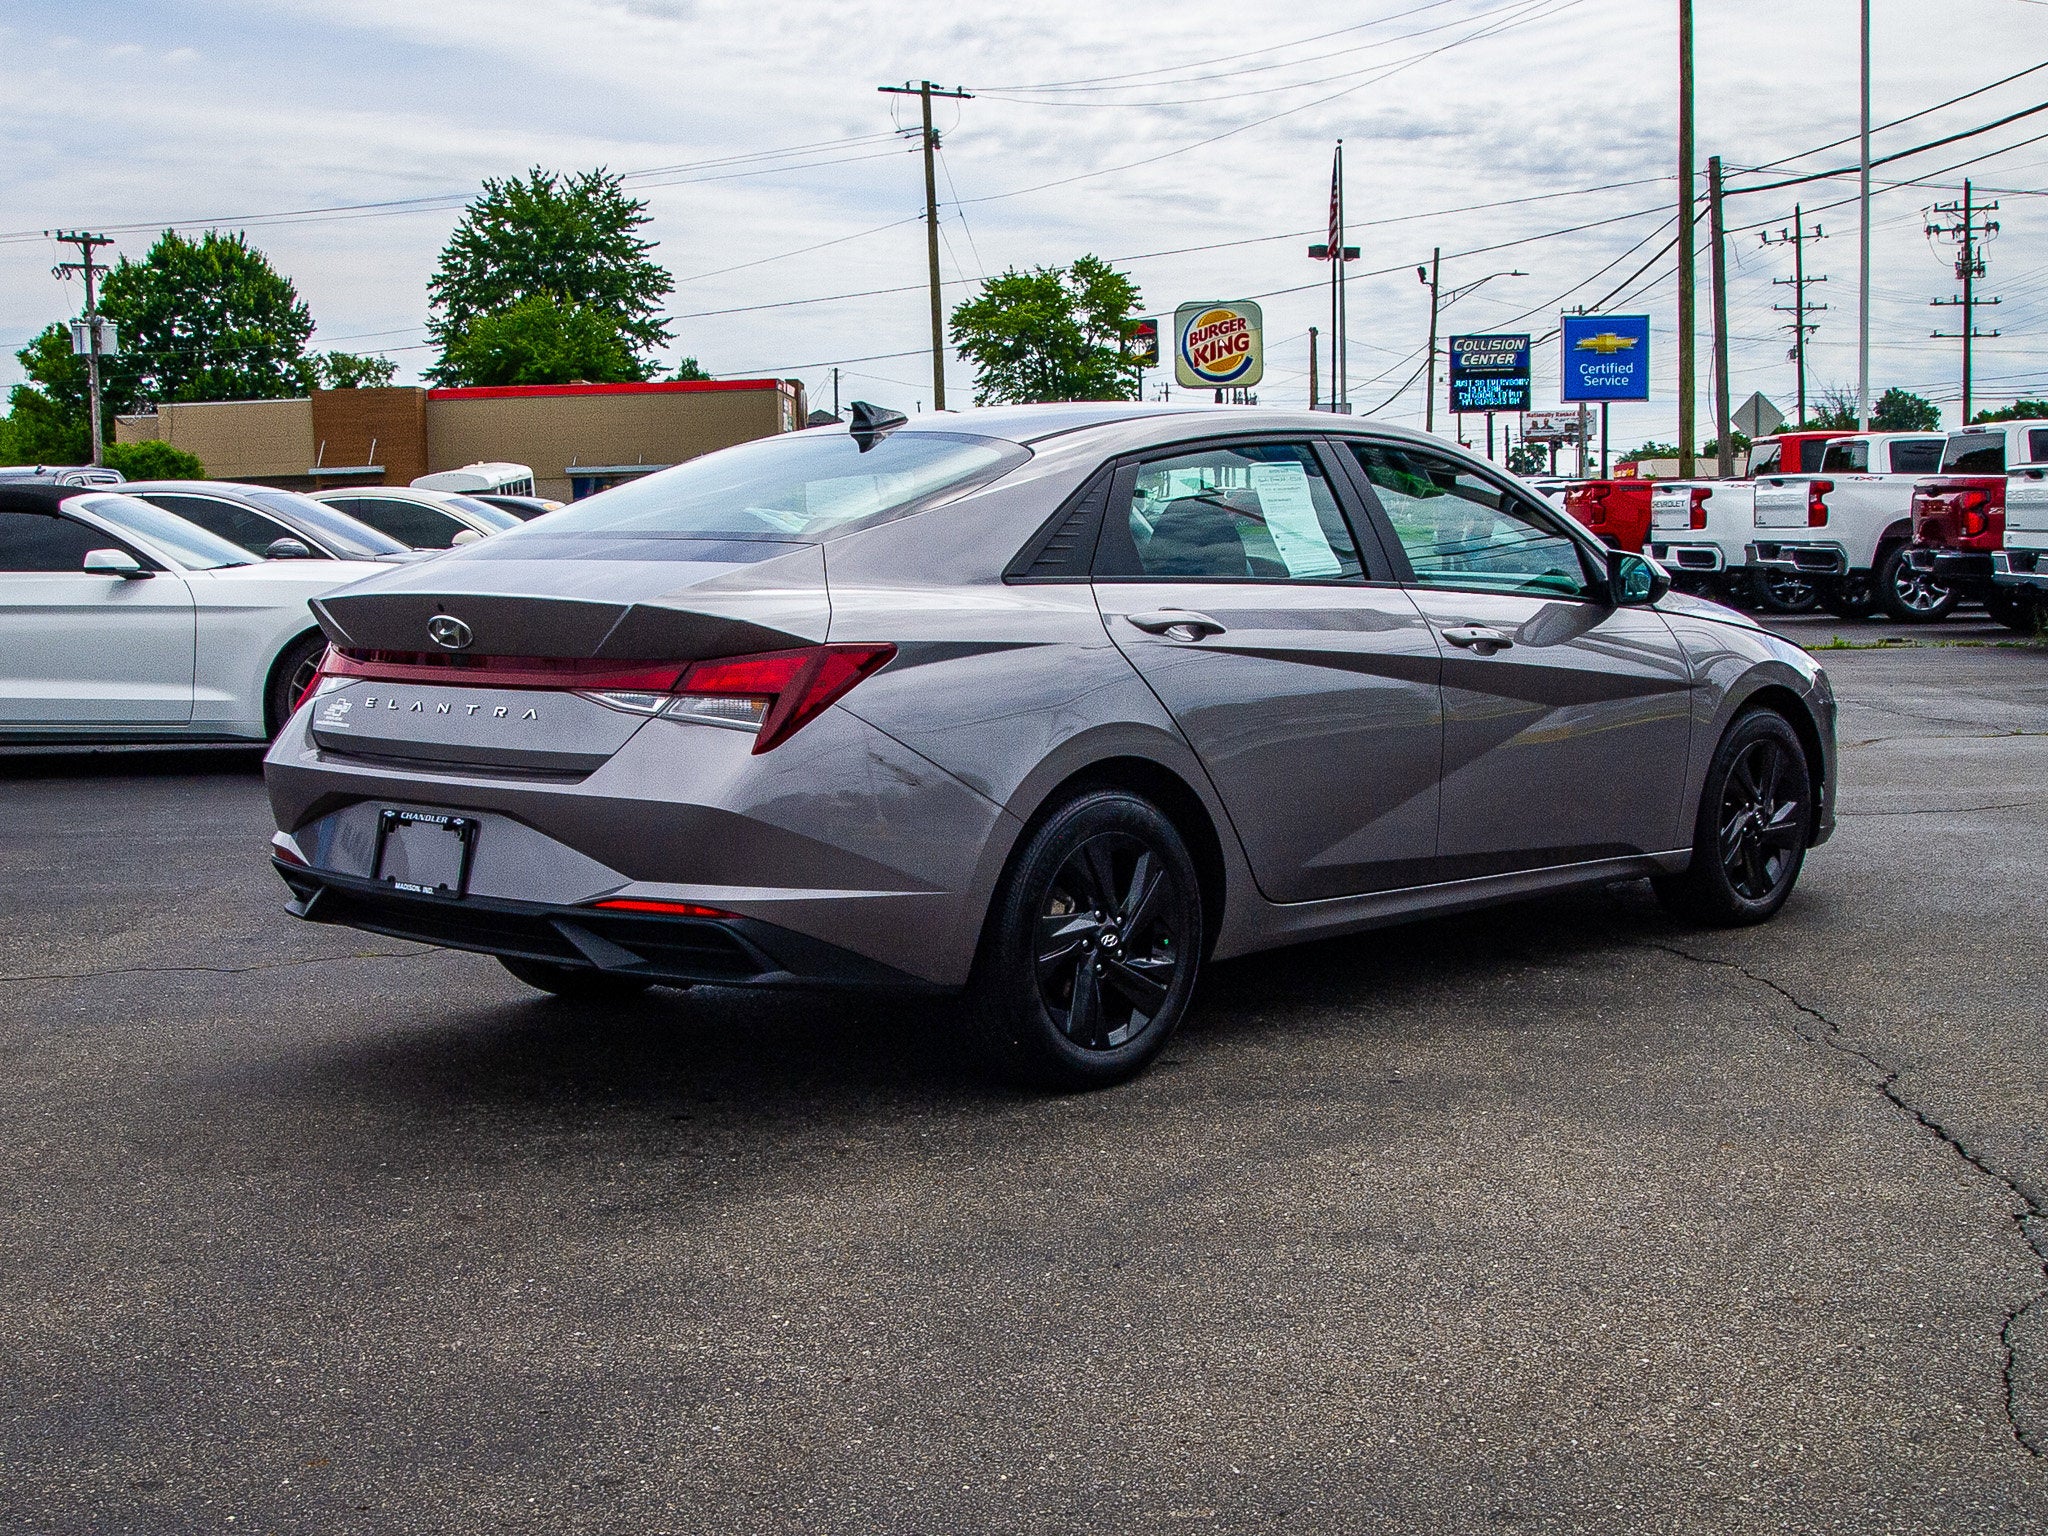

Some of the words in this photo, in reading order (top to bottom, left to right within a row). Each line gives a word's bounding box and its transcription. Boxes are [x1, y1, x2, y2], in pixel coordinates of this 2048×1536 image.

[1189, 318, 1246, 347] BURGER
[1194, 333, 1249, 367] KING
[1454, 339, 1525, 351] COLLISION
[1461, 353, 1515, 365] CENTER
[1580, 362, 1634, 374] Certified
[1454, 379, 1472, 387] JUST
[1475, 379, 1485, 387] SO
[1584, 375, 1629, 386] Service
[364, 697, 538, 720] ELANTRA
[400, 812, 448, 824] CHANDLER
